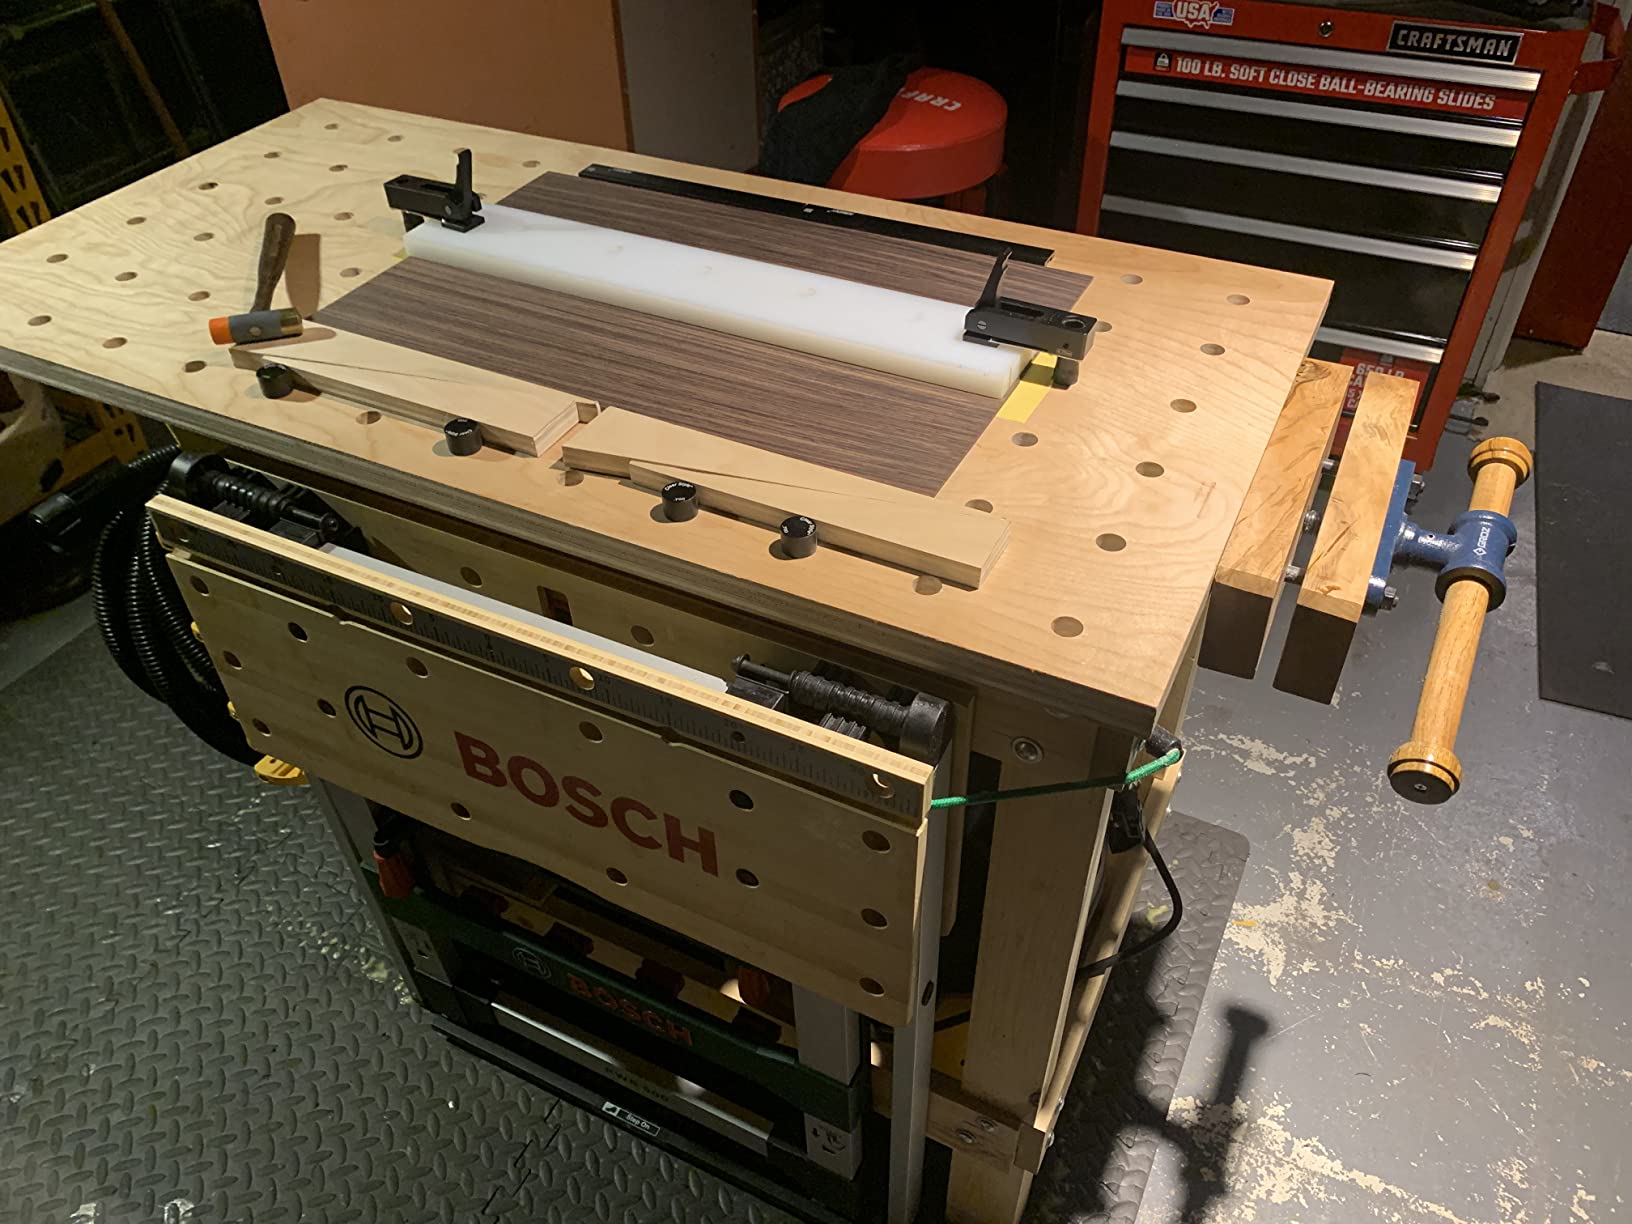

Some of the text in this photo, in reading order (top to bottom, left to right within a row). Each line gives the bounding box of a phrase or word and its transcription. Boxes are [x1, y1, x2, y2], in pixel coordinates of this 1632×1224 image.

[1176, 2, 1211, 21] USA
[1396, 29, 1513, 57] CRAFTSMAN
[1176, 56, 1497, 111] 100 LB. SOFT CLOSE BALL-BEARING SLIDES
[454, 730, 719, 877] BOSCH
[567, 973, 693, 1047] BOSCH
